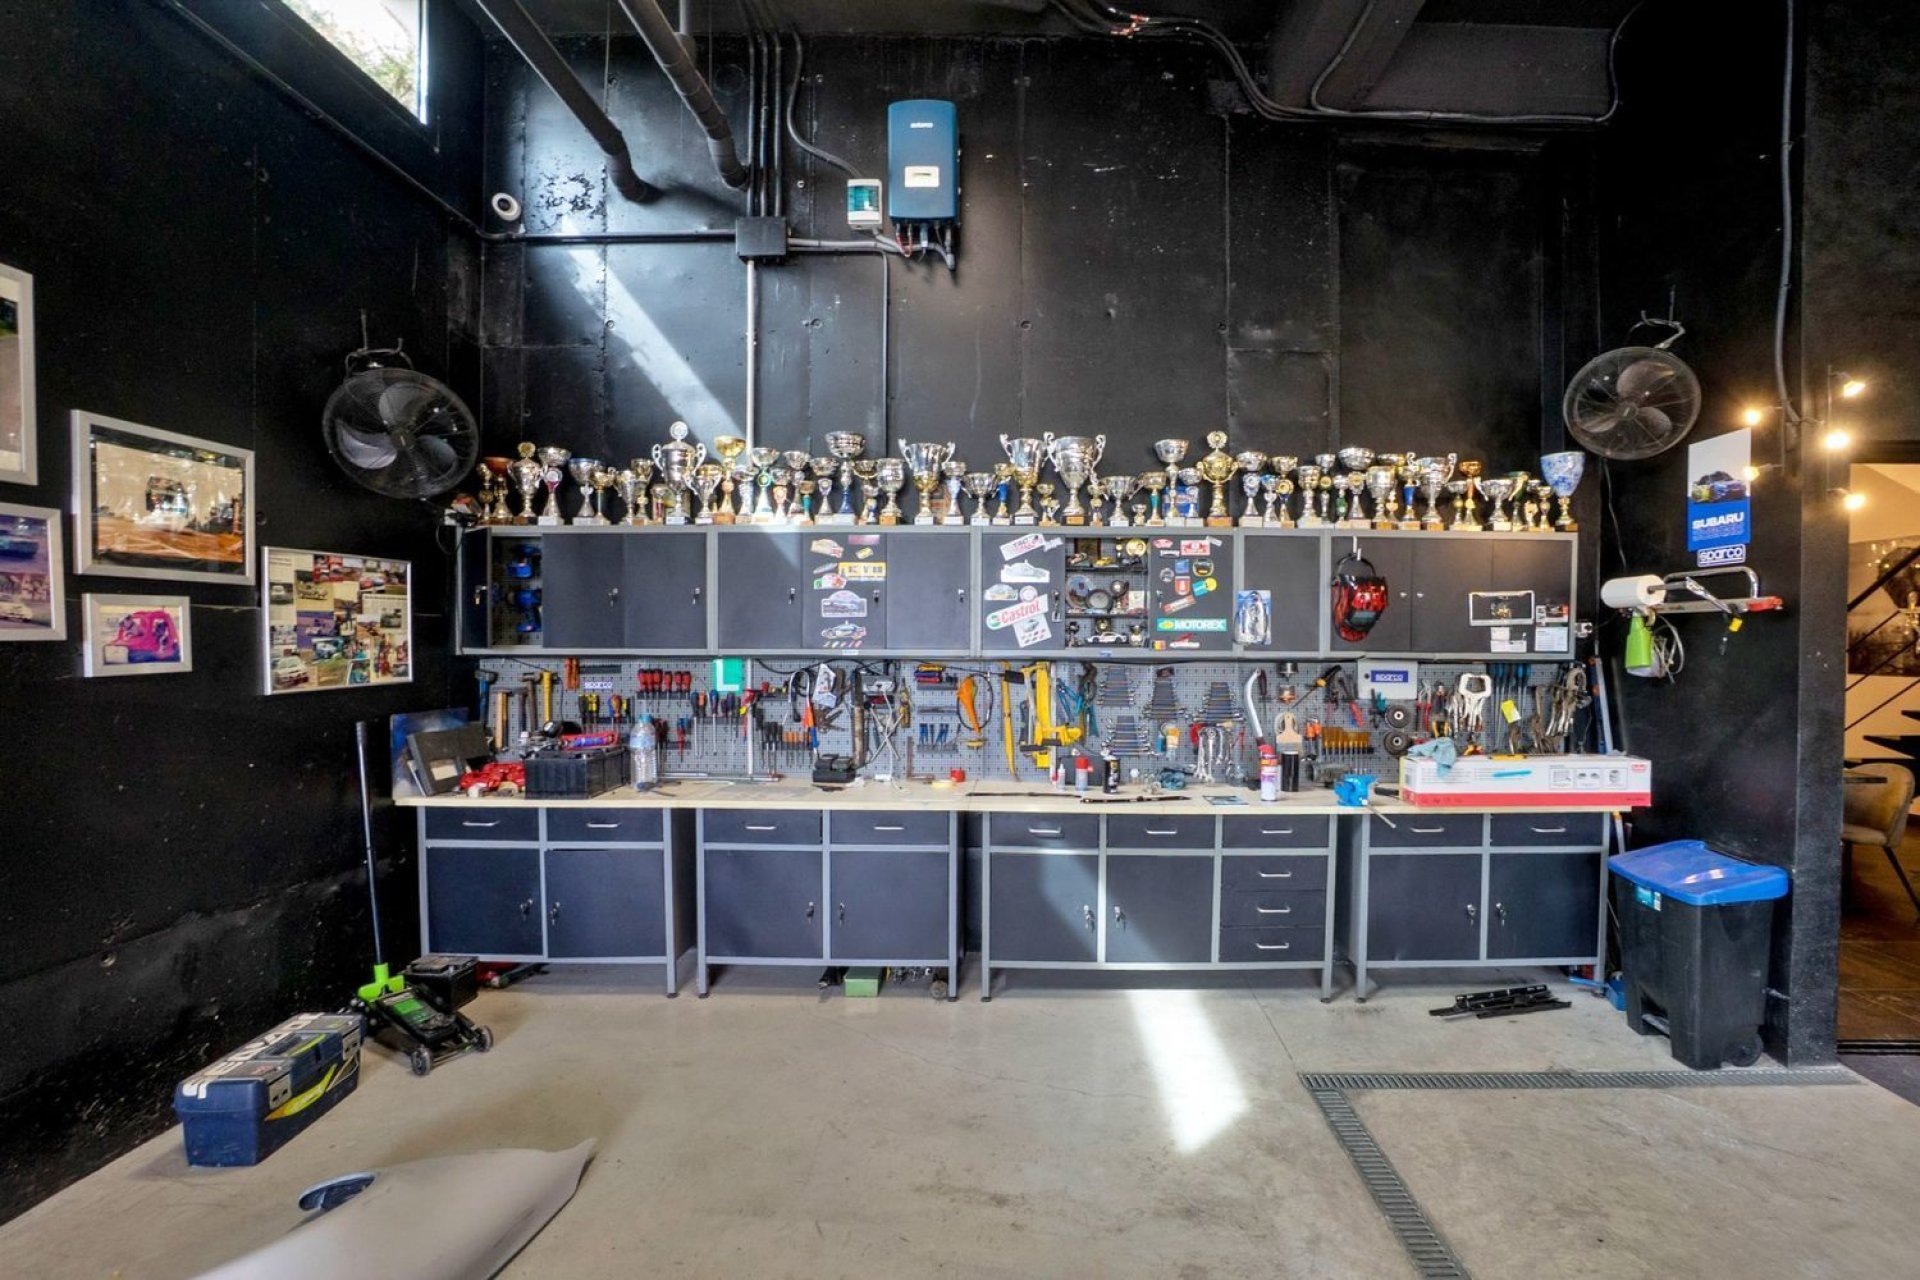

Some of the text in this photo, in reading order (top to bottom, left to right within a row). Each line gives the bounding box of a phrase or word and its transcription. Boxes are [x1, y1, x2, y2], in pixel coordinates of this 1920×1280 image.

[1692, 512, 1744, 529] SUBARU
[1001, 602, 1041, 623] Castrol
[1174, 619, 1225, 631] MOTOREX
[717, 659, 739, 691] L
